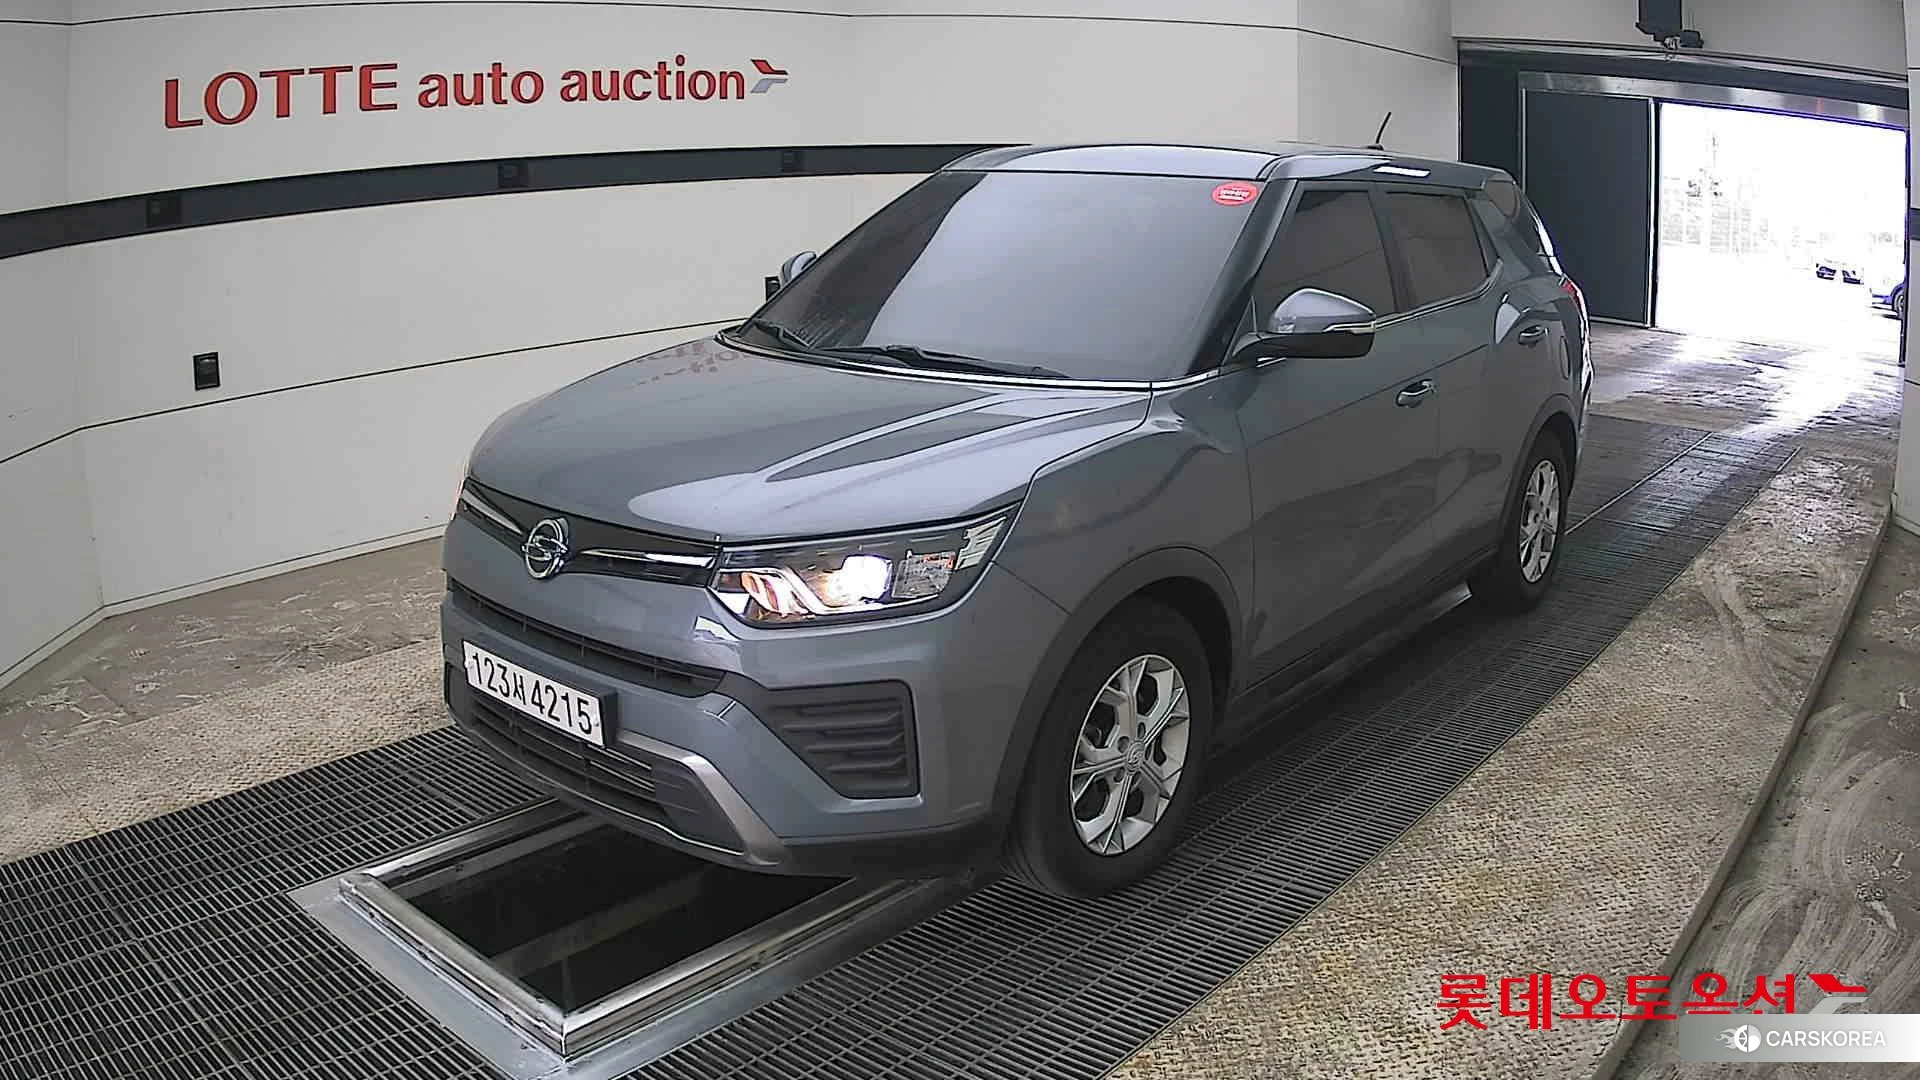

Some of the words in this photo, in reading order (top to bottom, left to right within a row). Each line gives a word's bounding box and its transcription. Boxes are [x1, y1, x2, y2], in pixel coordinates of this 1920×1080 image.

[164, 62, 399, 129] LOTTE
[417, 61, 545, 109] auto
[559, 54, 746, 102] auction
